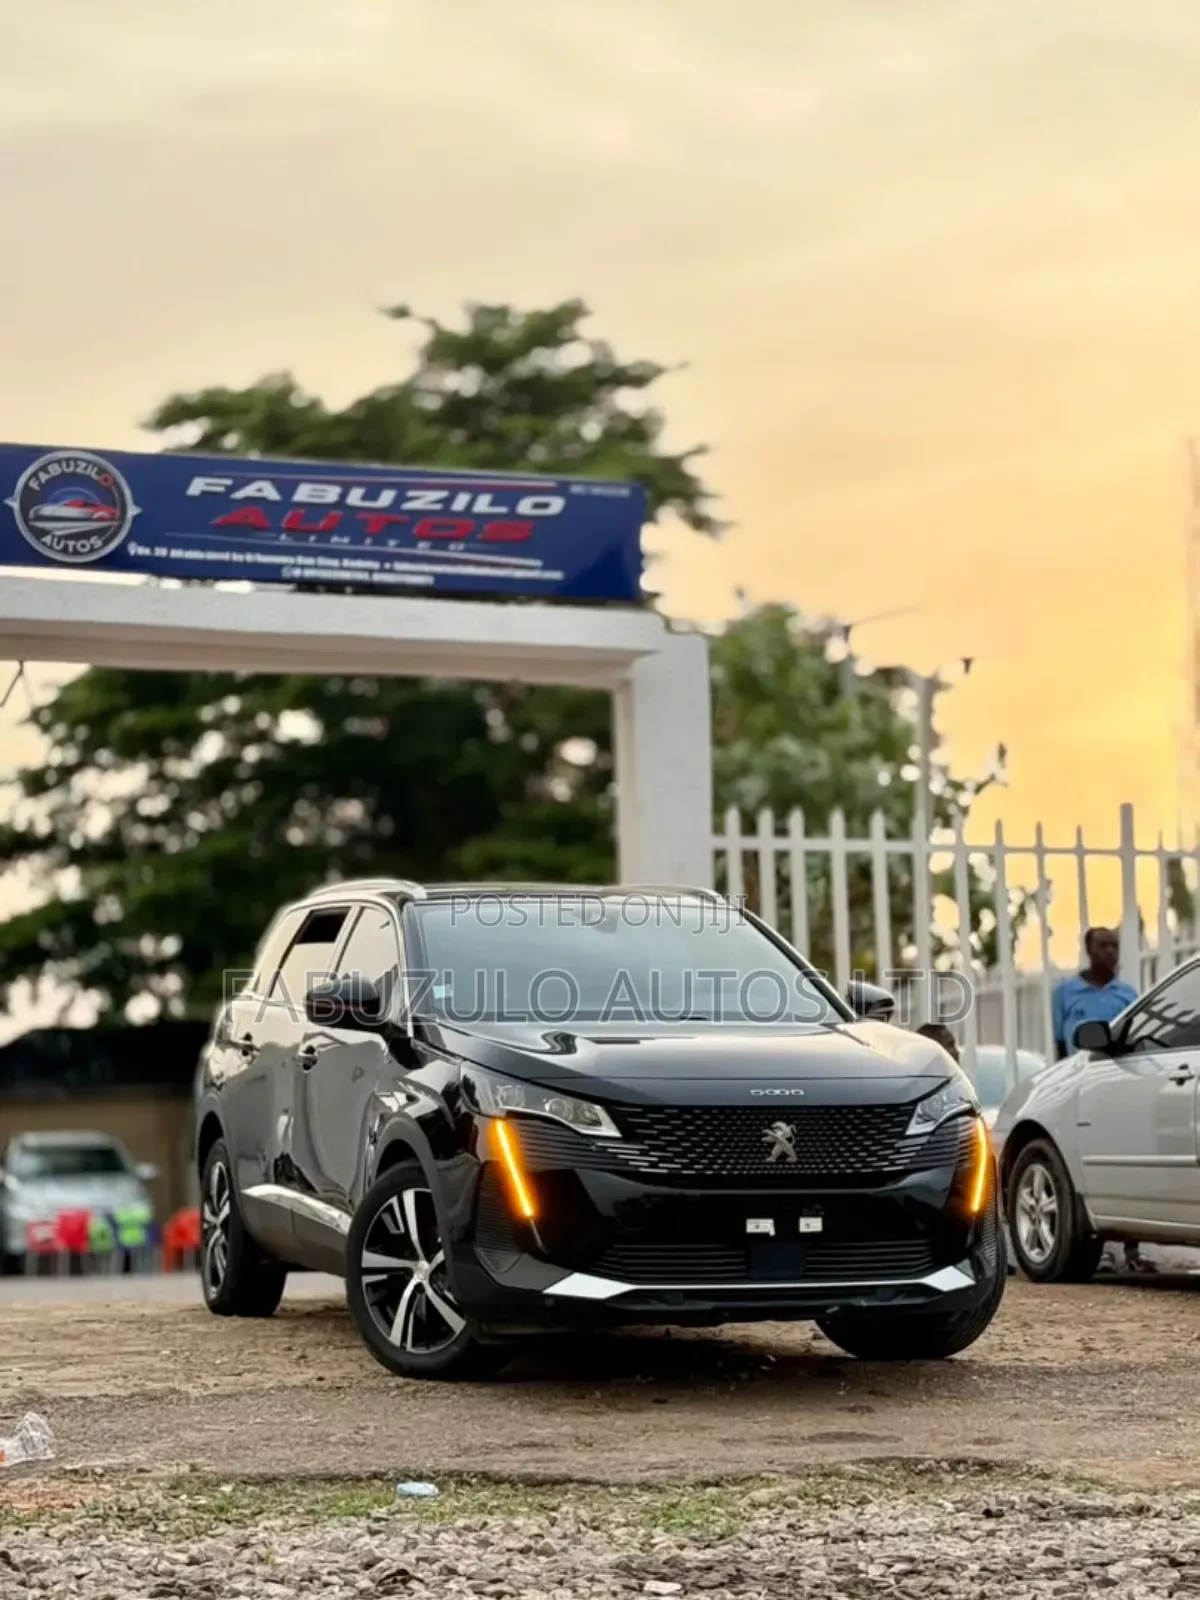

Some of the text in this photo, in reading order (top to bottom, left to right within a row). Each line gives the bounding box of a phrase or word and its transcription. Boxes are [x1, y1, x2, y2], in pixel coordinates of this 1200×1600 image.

[28, 459, 113, 490] FABUZILO
[186, 476, 567, 516] FABUZILO
[211, 506, 535, 542] AUTOS
[40, 533, 103, 554] AUTOS
[279, 533, 466, 551] LIMITED
